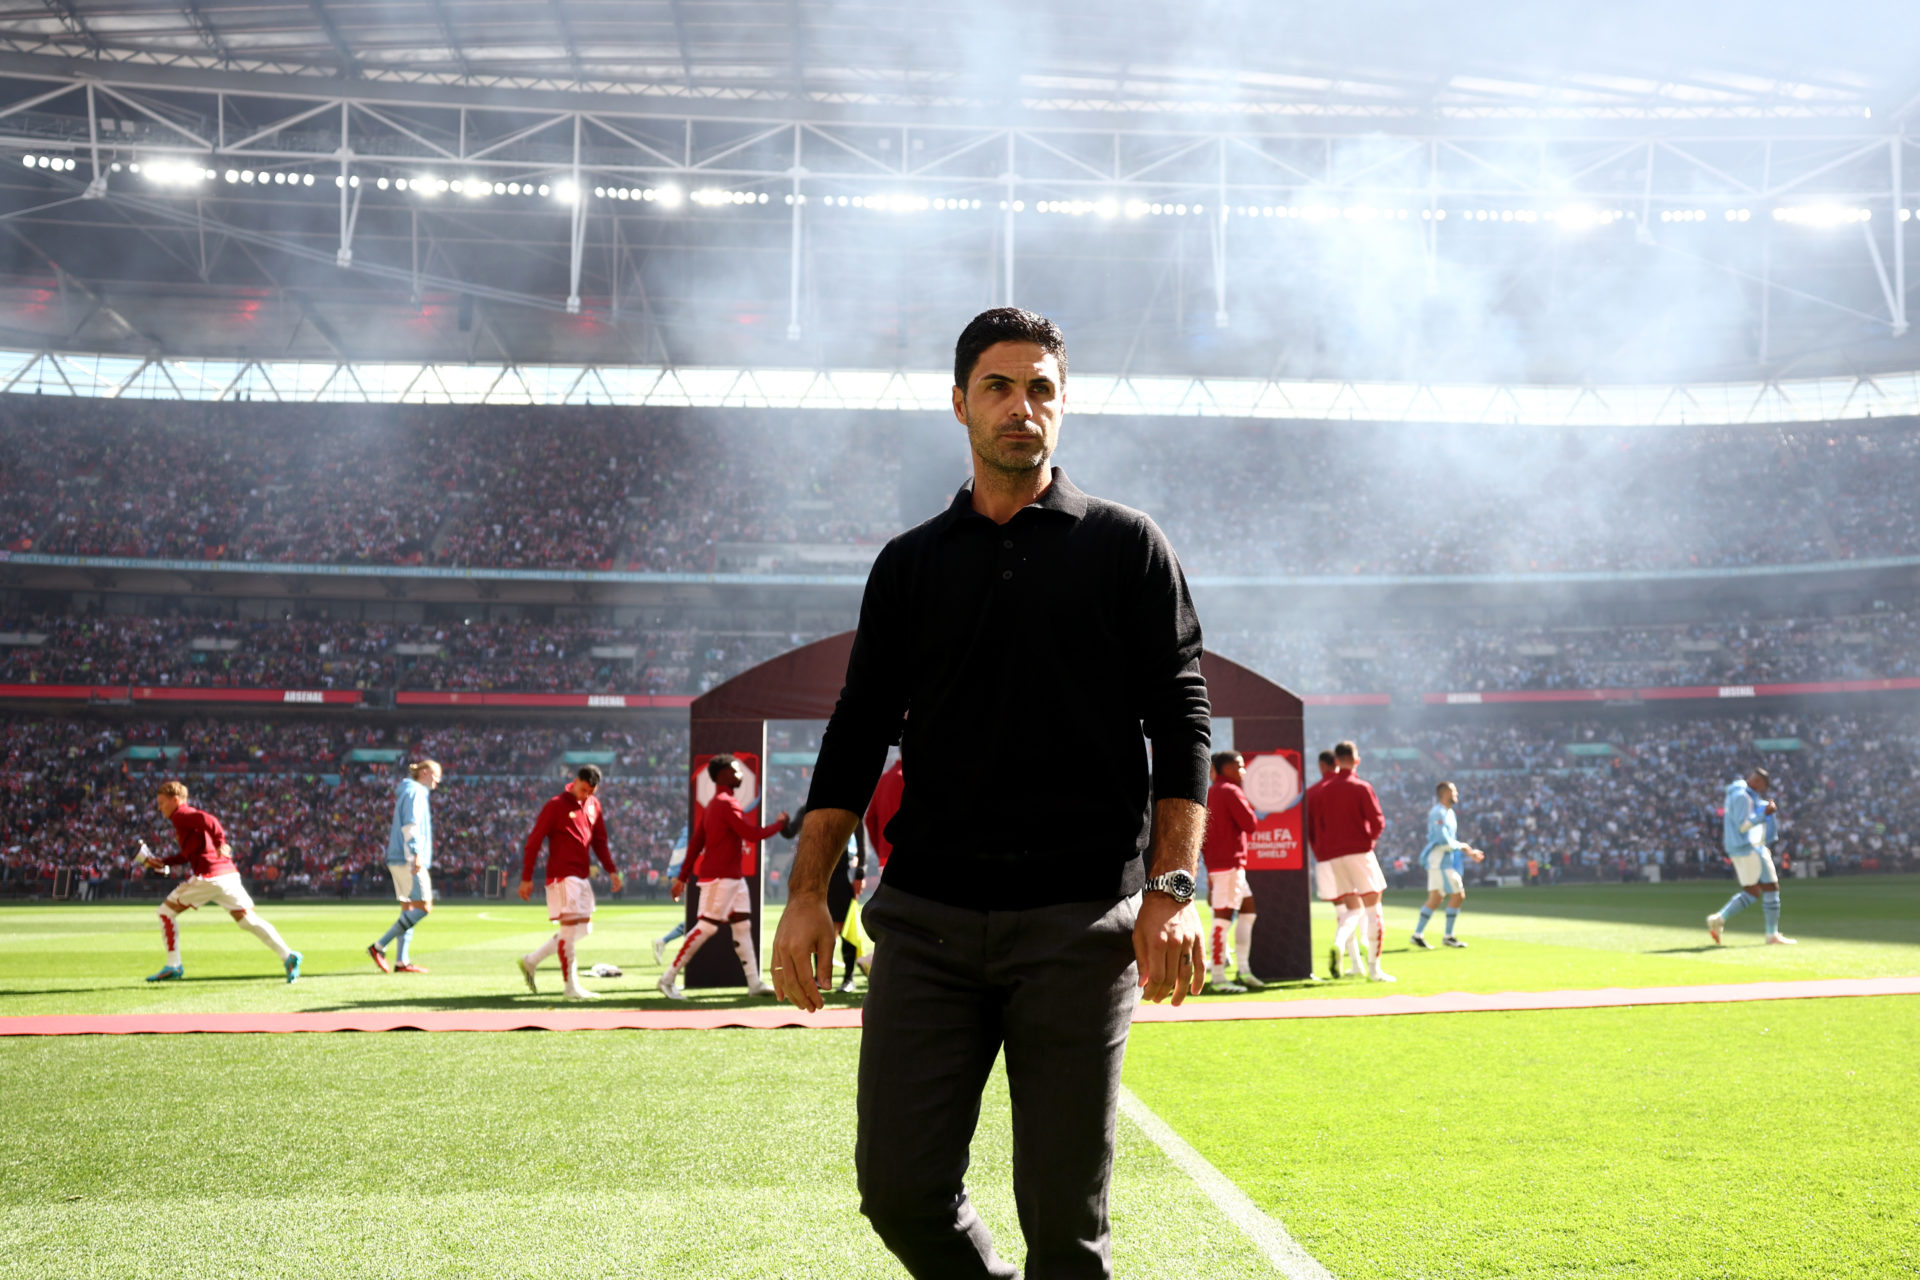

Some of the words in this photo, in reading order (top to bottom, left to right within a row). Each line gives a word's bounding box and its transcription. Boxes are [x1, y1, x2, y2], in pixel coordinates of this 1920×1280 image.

[284, 691, 323, 703] ARSENAL
[1719, 686, 1756, 698] ARSENAL
[588, 696, 626, 707] ARSENAL
[1252, 831, 1272, 841] THE
[1274, 828, 1292, 841] FA
[1247, 841, 1298, 850] COMMUNITY
[1257, 850, 1288, 859] SHIELD
